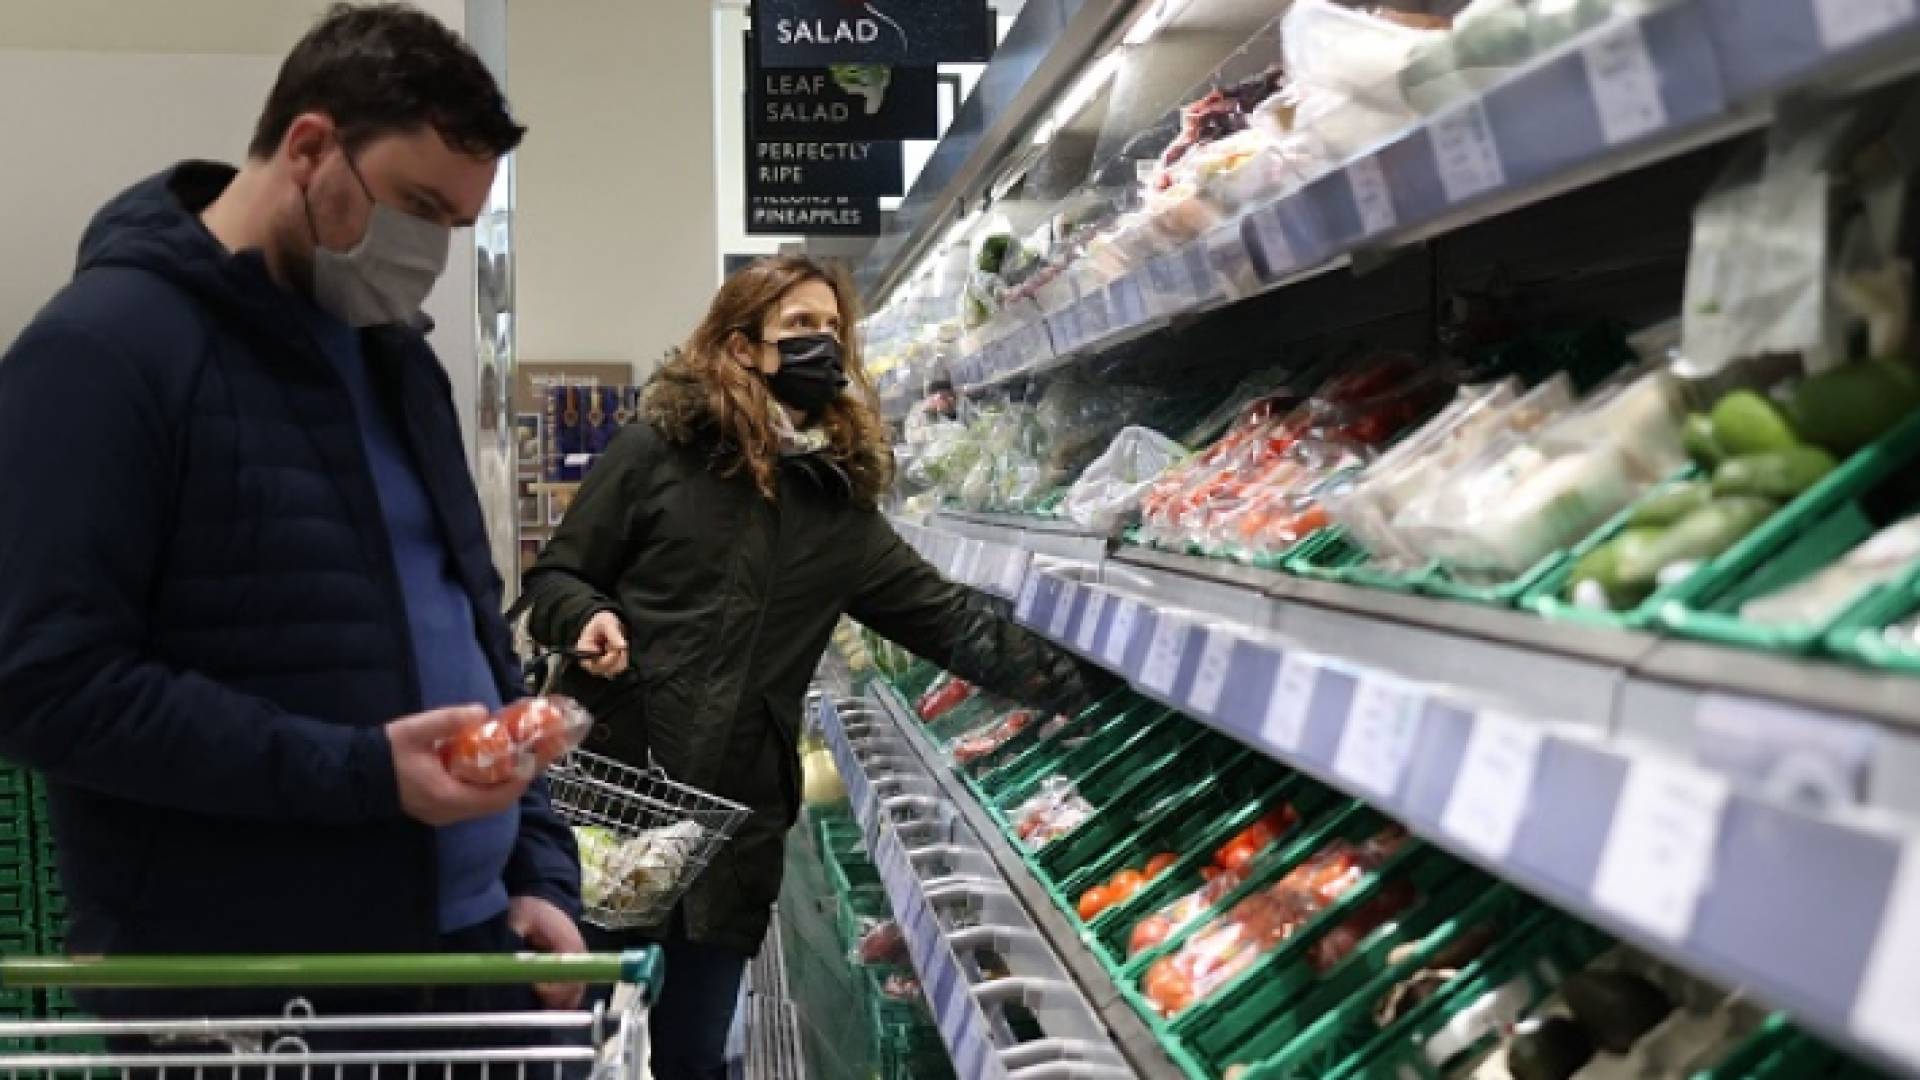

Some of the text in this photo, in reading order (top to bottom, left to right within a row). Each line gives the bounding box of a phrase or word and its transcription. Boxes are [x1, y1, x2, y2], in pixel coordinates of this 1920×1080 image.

[776, 18, 879, 44] SALAD
[766, 75, 825, 95] LEAF
[766, 102, 849, 122] SALAD
[757, 142, 872, 160] PERFECTLY
[759, 165, 805, 184] RIPE
[752, 209, 862, 225] PINEAPPLES
